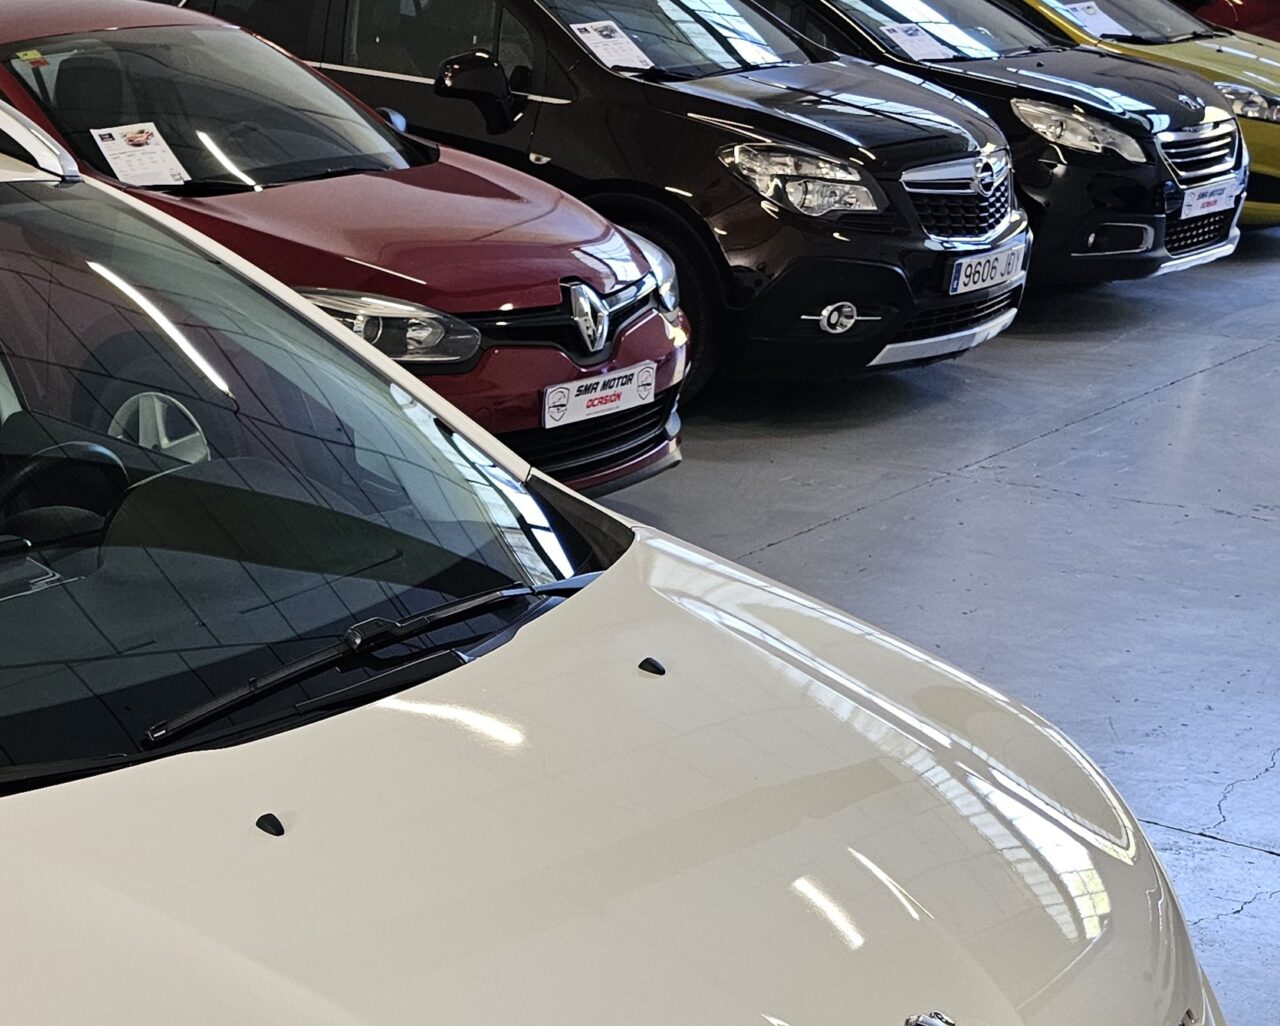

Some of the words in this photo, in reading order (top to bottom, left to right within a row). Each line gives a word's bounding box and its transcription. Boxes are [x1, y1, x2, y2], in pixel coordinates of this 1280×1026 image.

[963, 257, 998, 287] 9606
[574, 382, 600, 397] SMA
[600, 373, 634, 392] MOTOR
